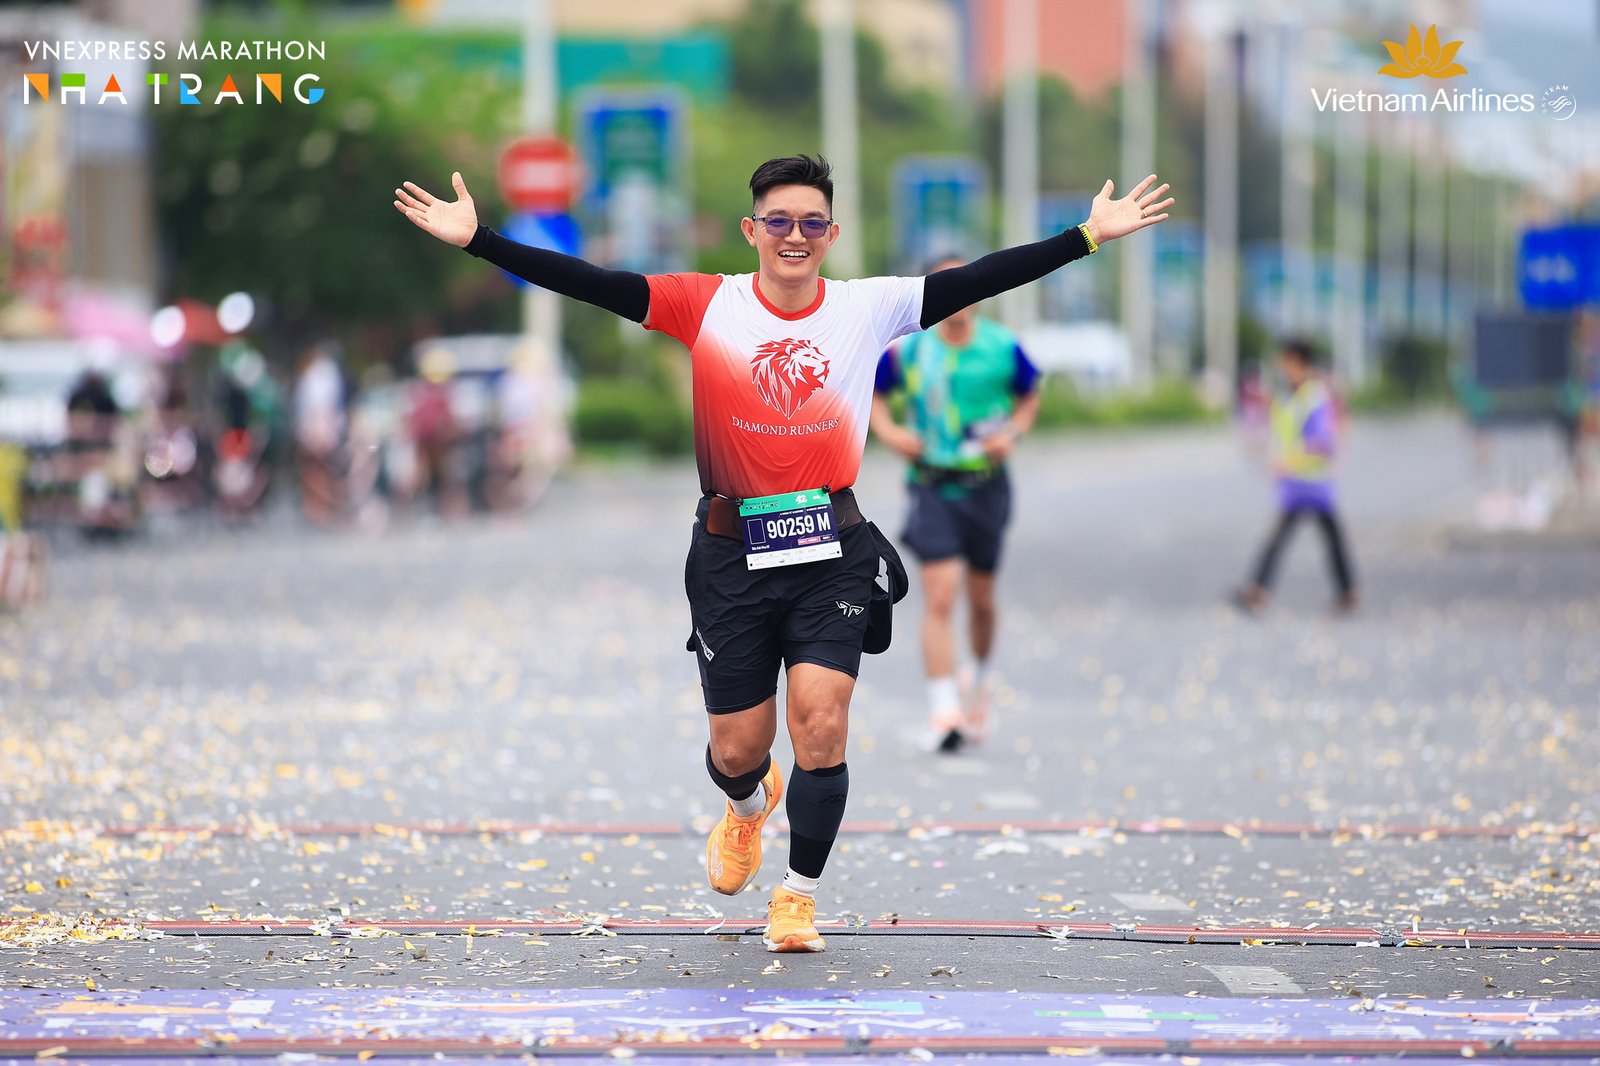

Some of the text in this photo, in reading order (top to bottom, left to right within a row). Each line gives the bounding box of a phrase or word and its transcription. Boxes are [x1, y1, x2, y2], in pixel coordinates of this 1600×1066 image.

[731, 415, 840, 436] DIAMOND RUNNERS
[766, 512, 831, 539] 90259 M
